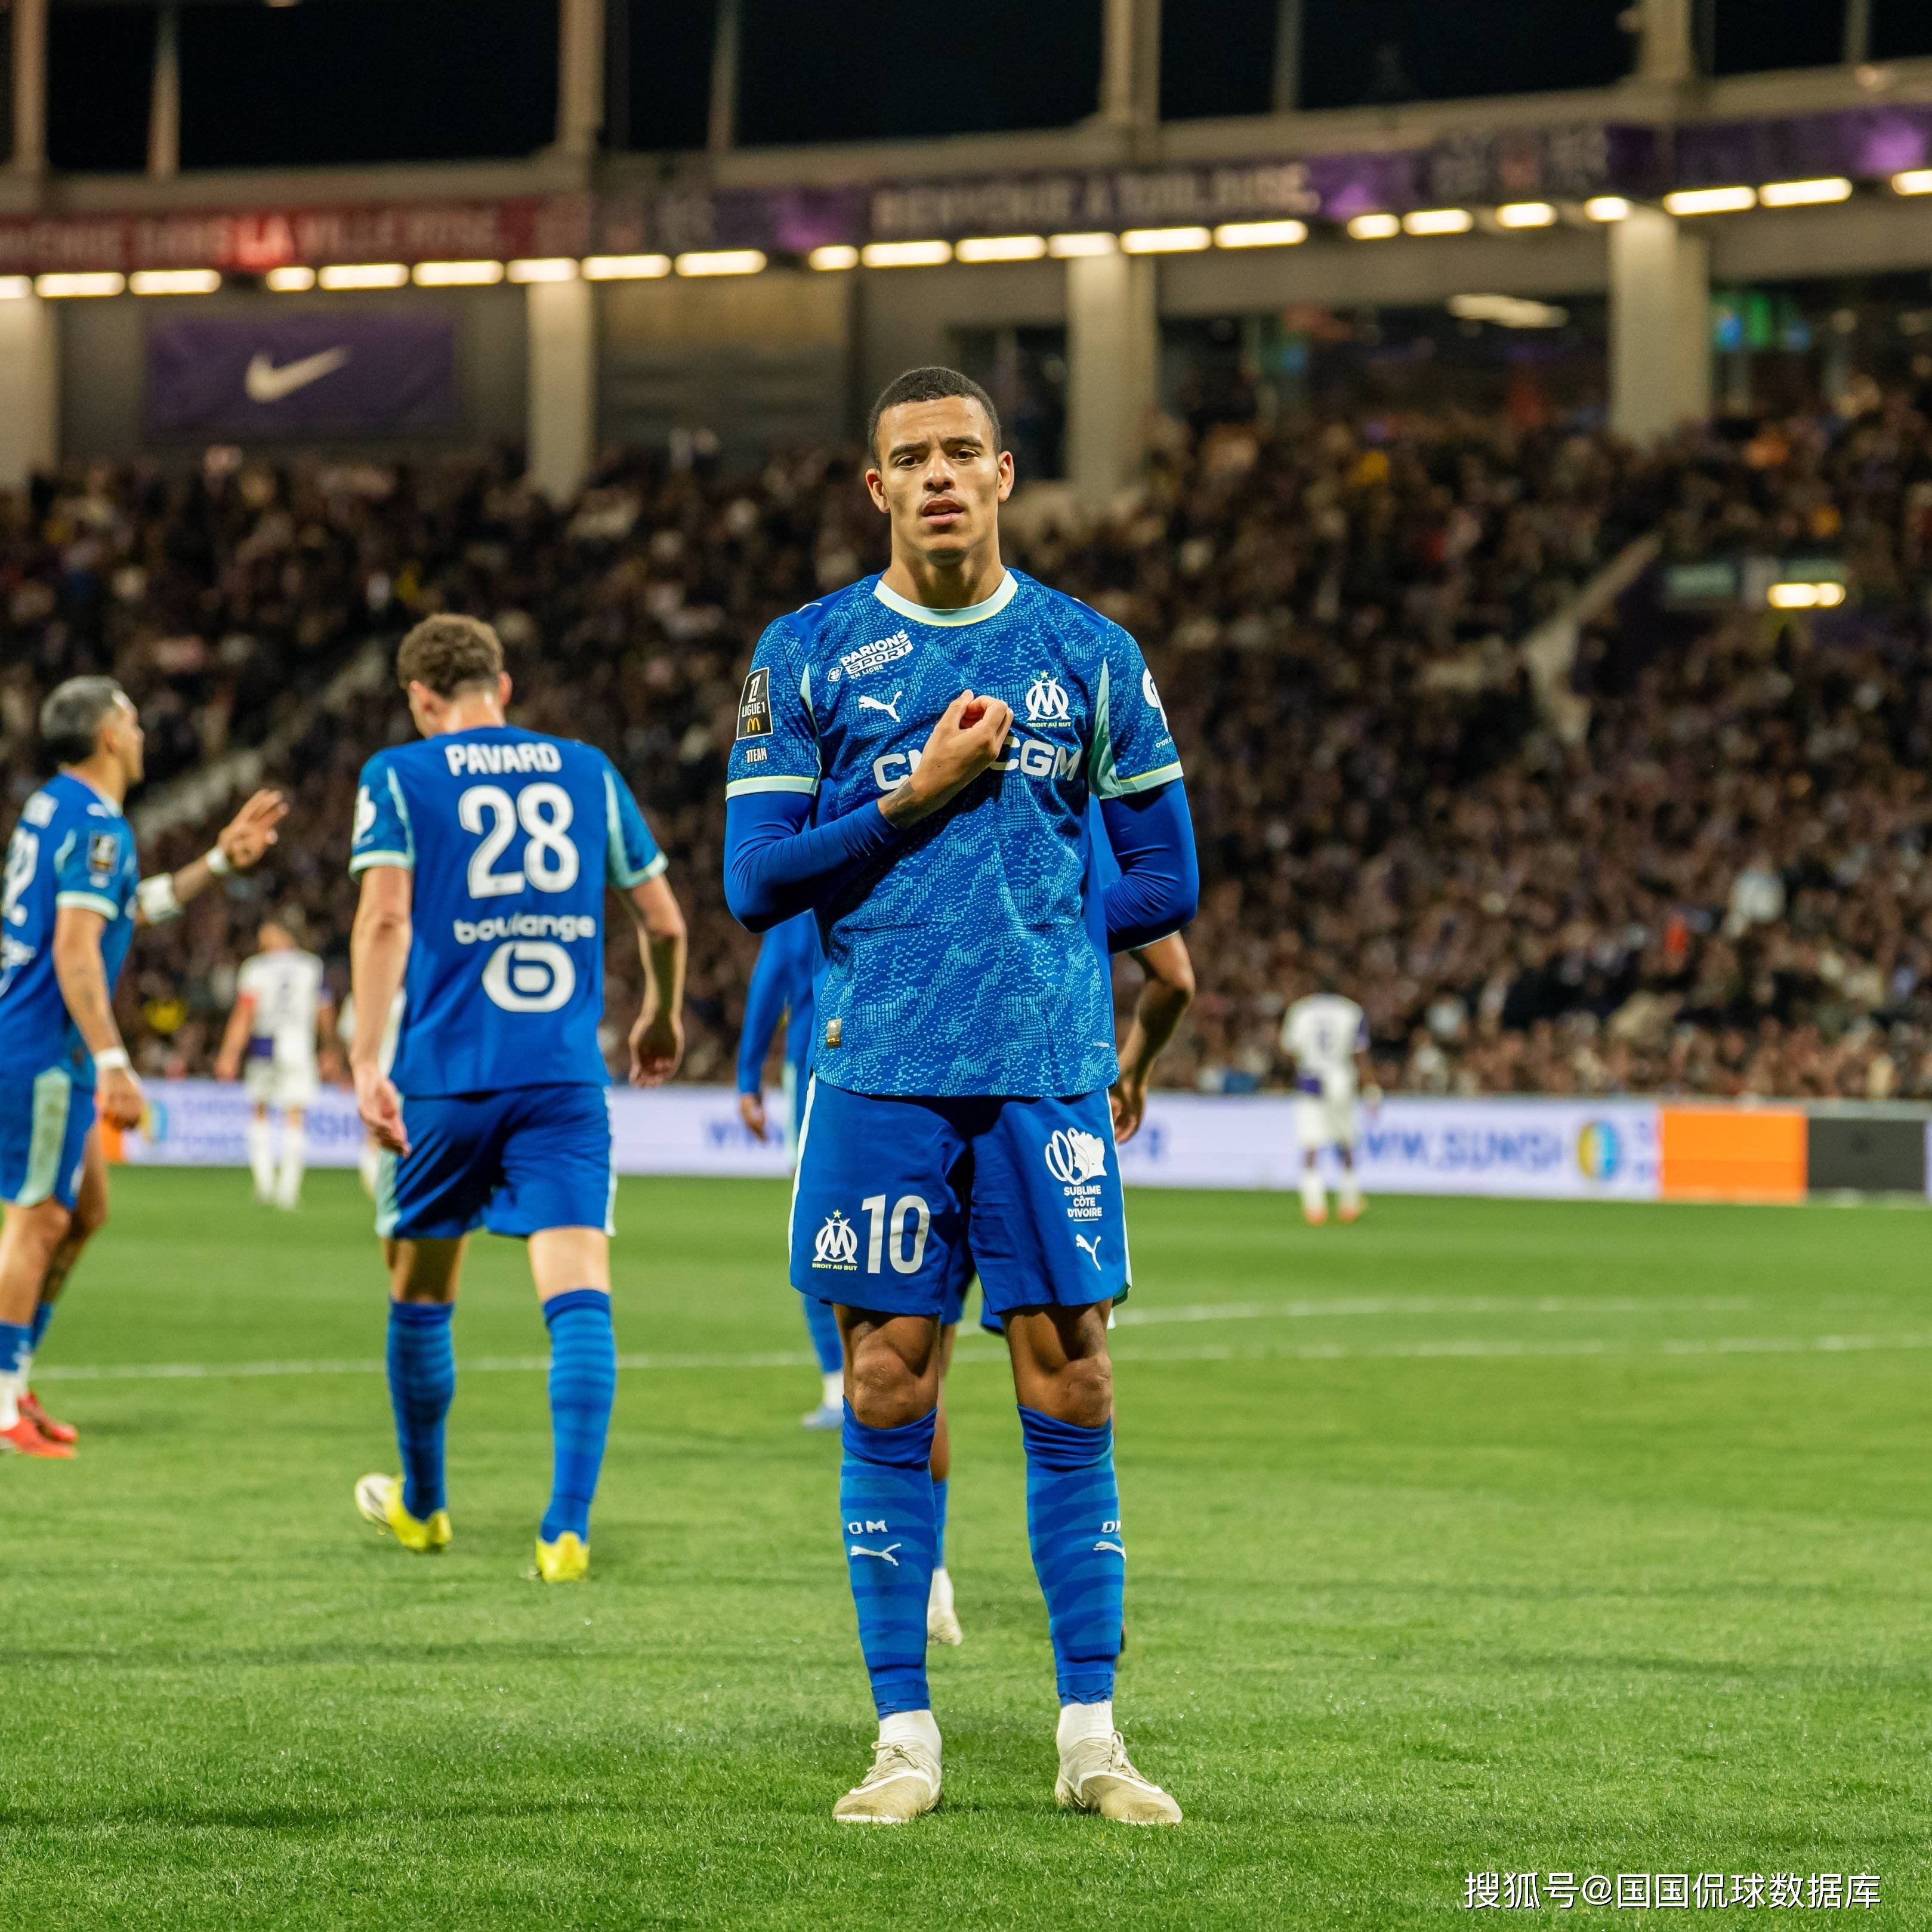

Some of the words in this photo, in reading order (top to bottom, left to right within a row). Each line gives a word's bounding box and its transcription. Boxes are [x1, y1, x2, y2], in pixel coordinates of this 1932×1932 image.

[840, 629, 909, 666] PARIONS
[850, 643, 909, 672] SPORT
[862, 665, 884, 675] LIGNE
[445, 742, 563, 776] PAVARD
[746, 747, 767, 763] 1TEAM
[458, 782, 580, 899] 28
[1063, 1185, 1101, 1196] SUBLIME
[1073, 1195, 1096, 1207] CÔTE
[1067, 1206, 1103, 1218] D'IVOIRE
[861, 1194, 930, 1274] 10
[848, 1519, 888, 1535] OM
